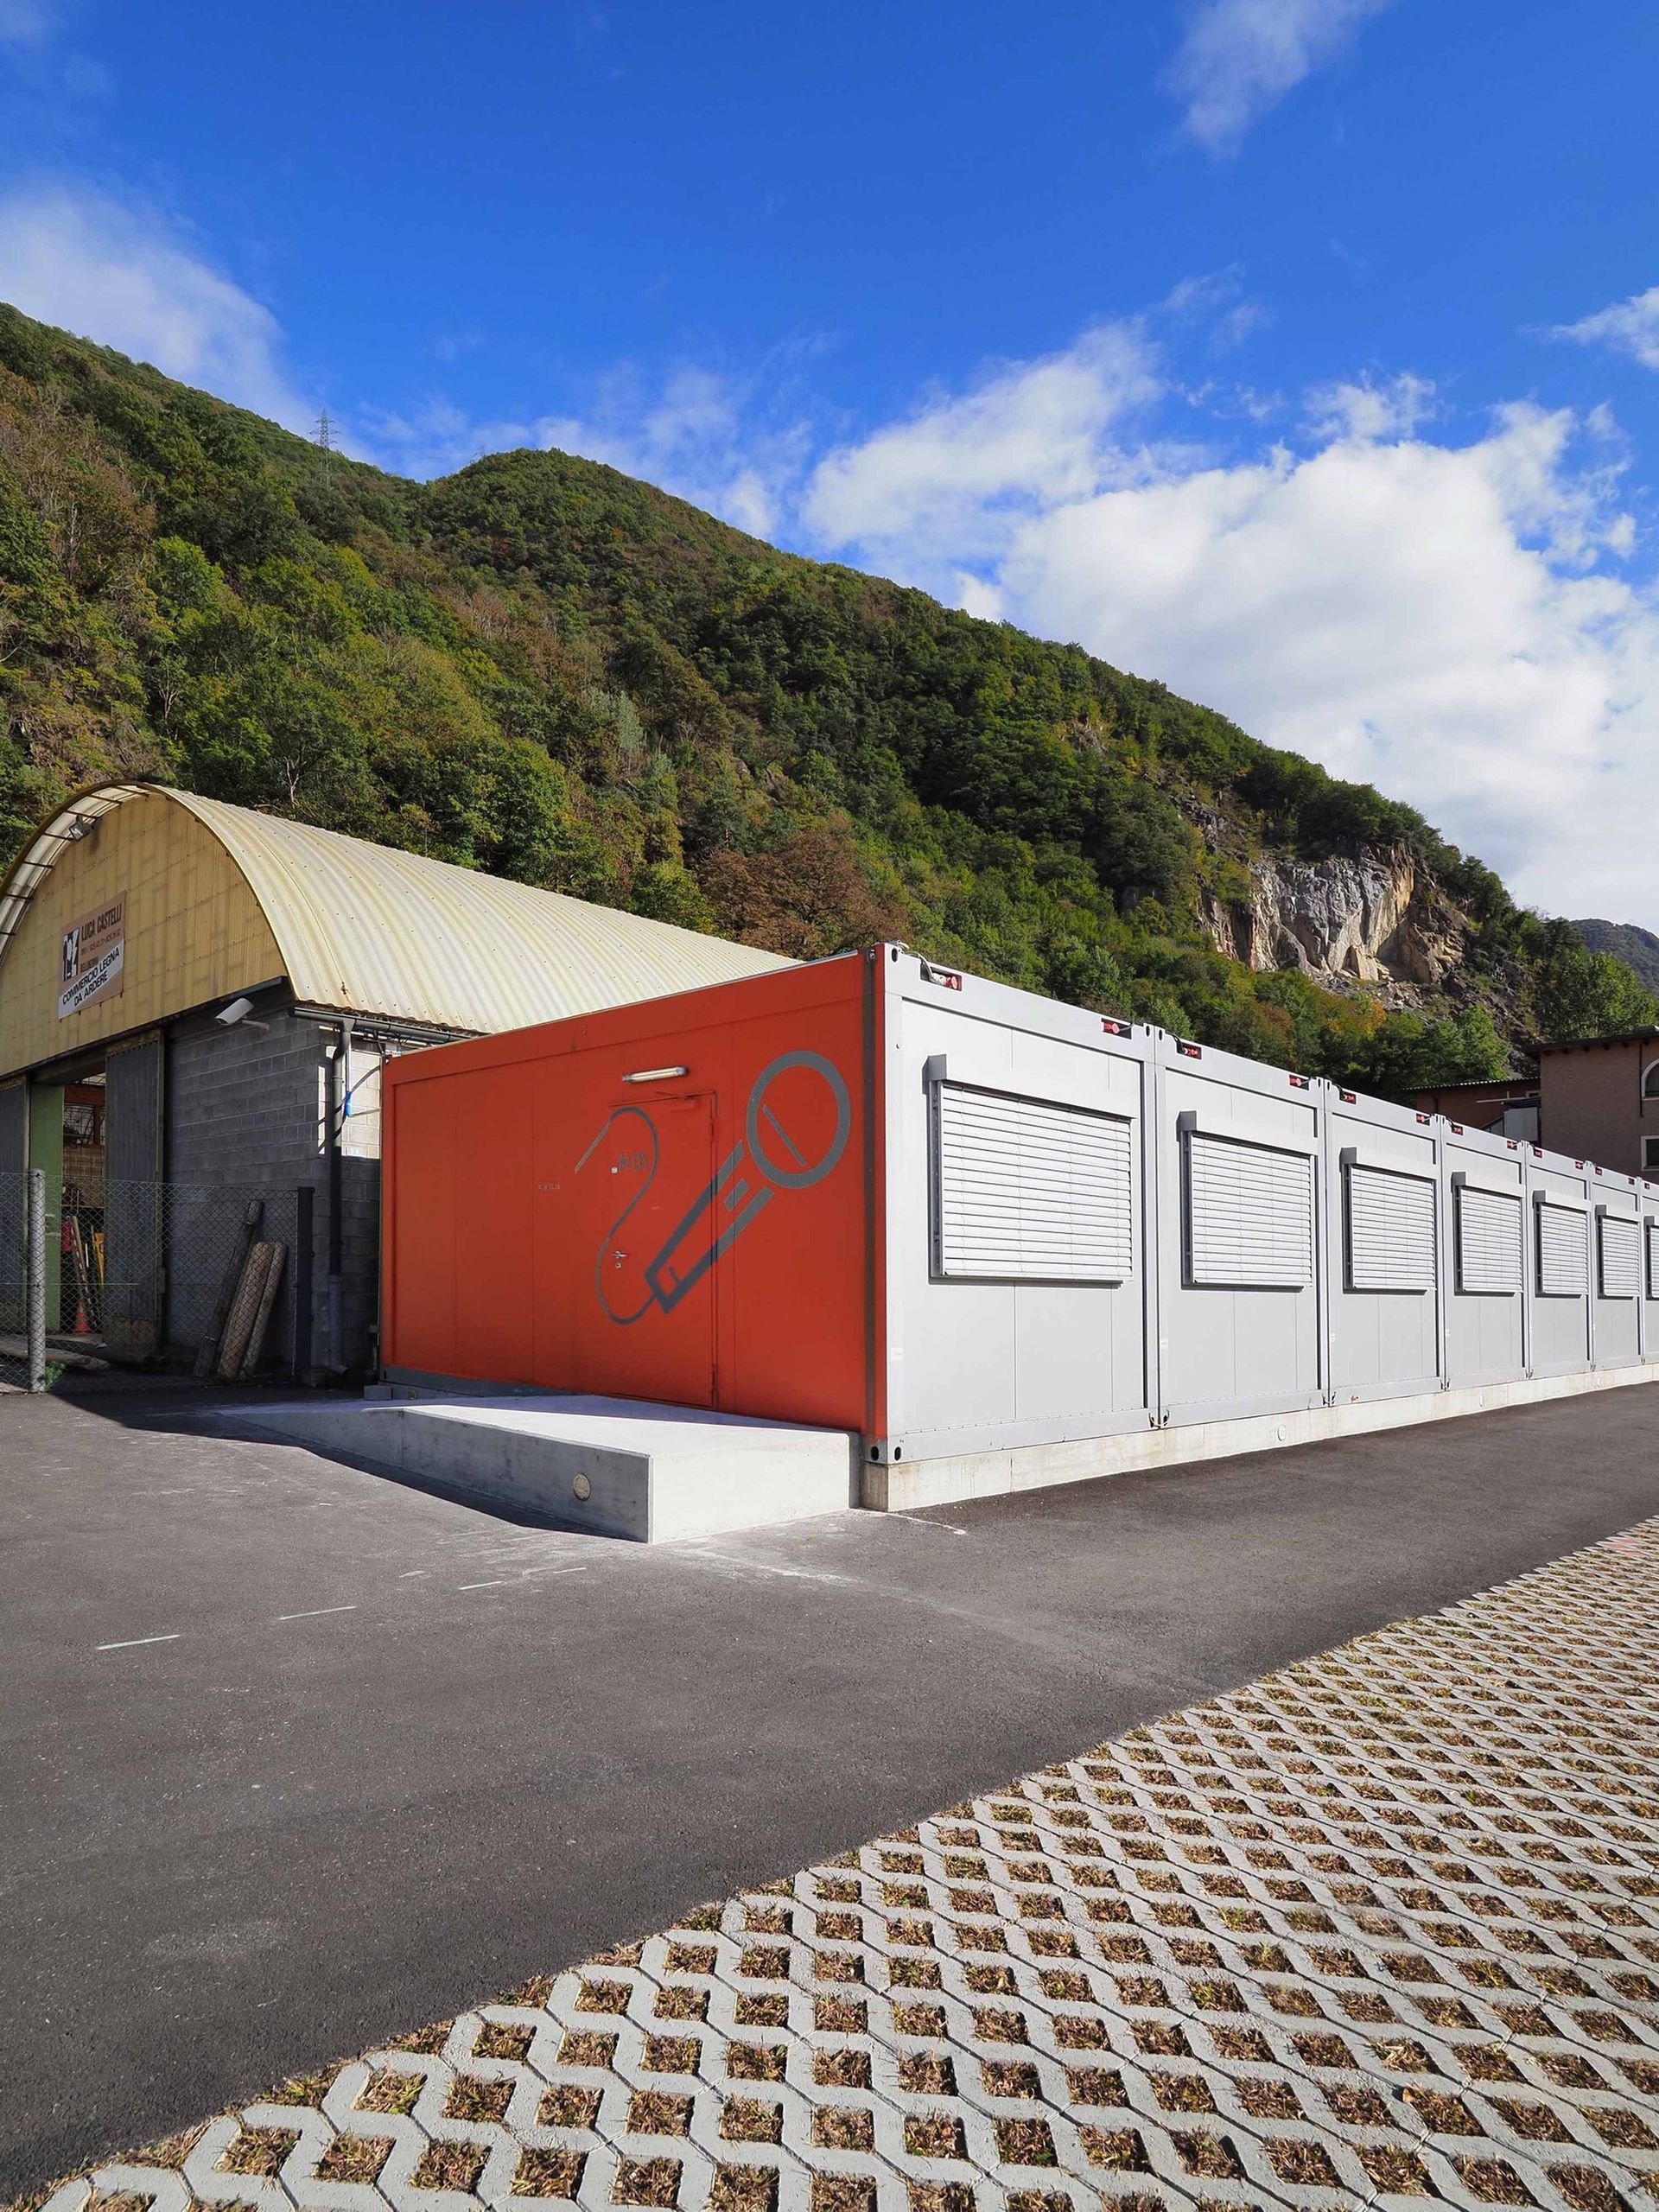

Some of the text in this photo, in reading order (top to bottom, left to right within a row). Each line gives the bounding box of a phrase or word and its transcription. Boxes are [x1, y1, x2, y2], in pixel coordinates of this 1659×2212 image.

[81, 903, 122, 942] LUCA CASTELLI
[62, 969, 99, 1005] COMMERCIO
[99, 947, 120, 974] LEGNA
[74, 970, 109, 1007] DA ARDERE
